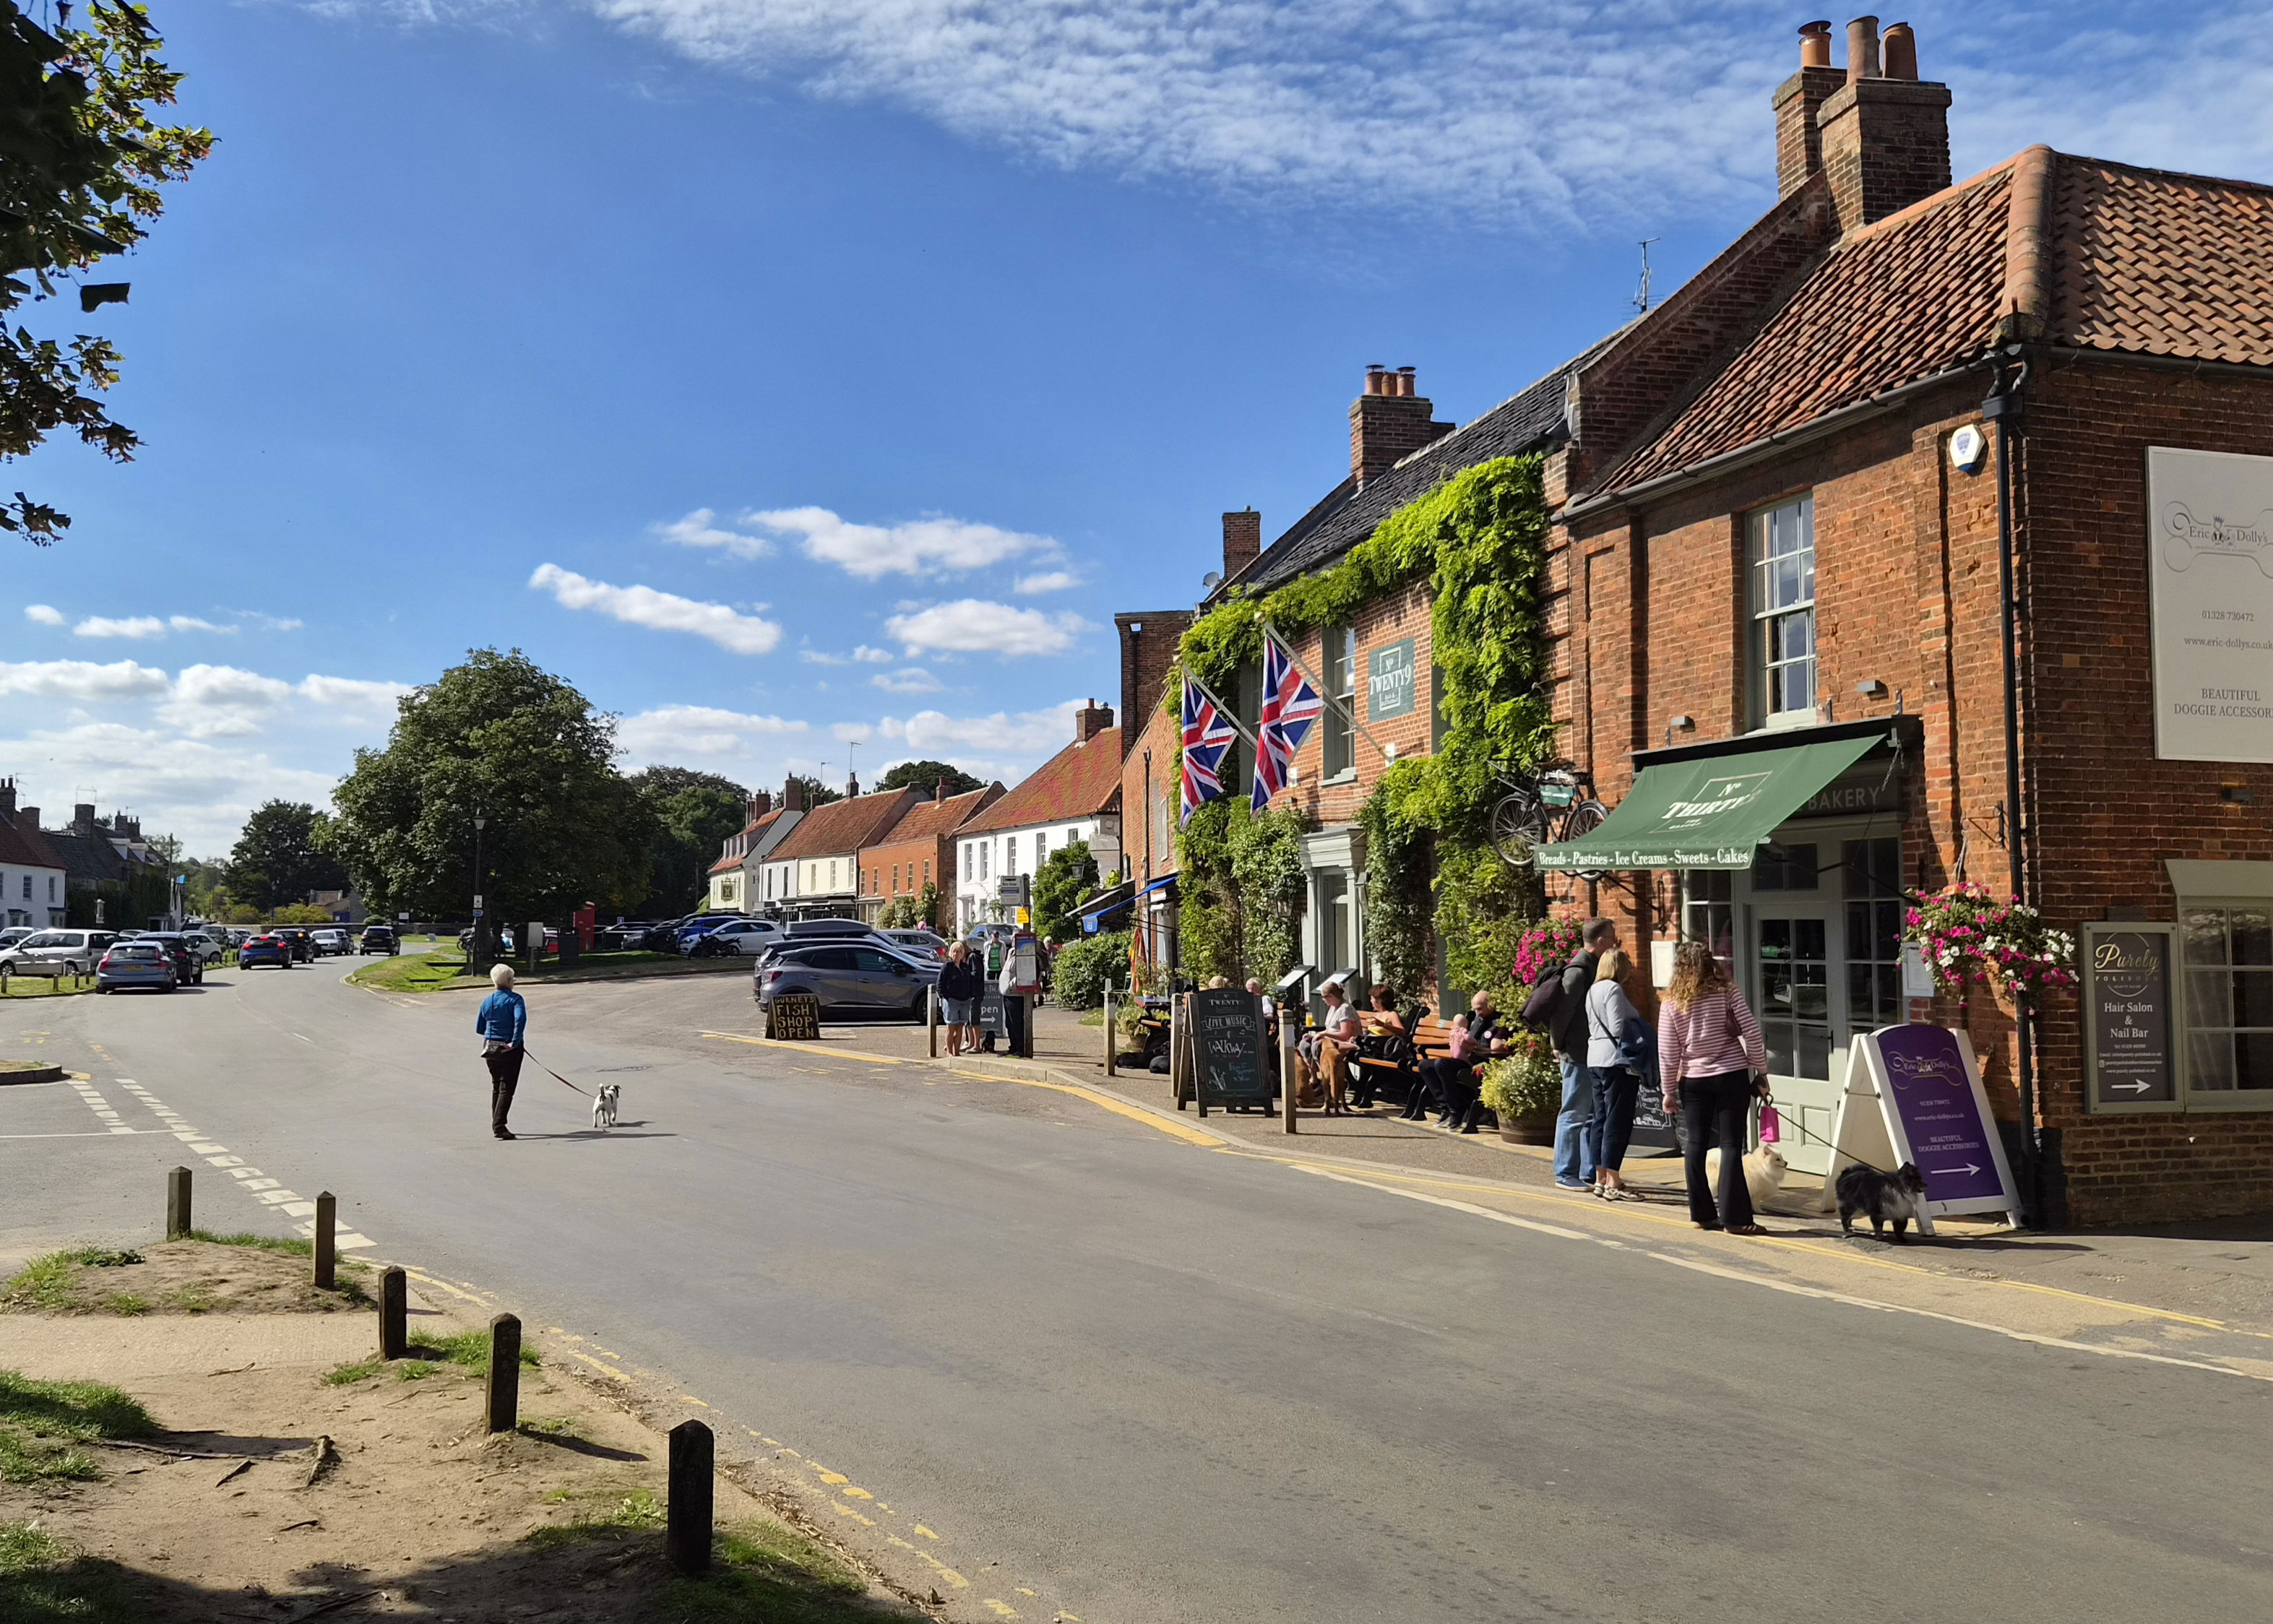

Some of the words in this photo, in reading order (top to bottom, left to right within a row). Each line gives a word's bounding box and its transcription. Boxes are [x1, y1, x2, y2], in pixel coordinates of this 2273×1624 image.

[2189, 526, 2210, 538] Eric
[2236, 530, 2268, 546] Dolly's
[2201, 610, 2225, 620] 01328
[2227, 612, 2254, 621] 730472
[2183, 637, 2273, 650] www.eric-dollys.co.uk
[2201, 688, 2261, 701] BEAUTIFUL
[2174, 703, 2217, 716] DOGGIE
[1808, 787, 1880, 811] BAKERY
[1538, 852, 1566, 865] Breads
[1572, 851, 1608, 865] Pastries
[1615, 851, 1629, 865] Ice
[1631, 851, 1668, 865] Creams
[1674, 850, 1709, 864] Sweets
[1717, 848, 1748, 863] Cakes
[2095, 943, 2160, 975] Purely
[777, 1004, 809, 1016] FISH
[981, 1006, 998, 1015] pen
[2104, 1002, 2125, 1012] Hair
[2126, 1002, 2153, 1012] Salon
[778, 1016, 813, 1027] SHOP
[1208, 1017, 1223, 1027] LIVE
[1225, 1016, 1246, 1026] MUSIC
[2125, 1015, 2133, 1025] &
[779, 1027, 814, 1038] OPEN
[2110, 1028, 2129, 1038] Nail
[2132, 1028, 2149, 1038] Bar
[1930, 1134, 1963, 1143] BEAUTIFUL
[1942, 1141, 1980, 1150] ACCESSORIES
